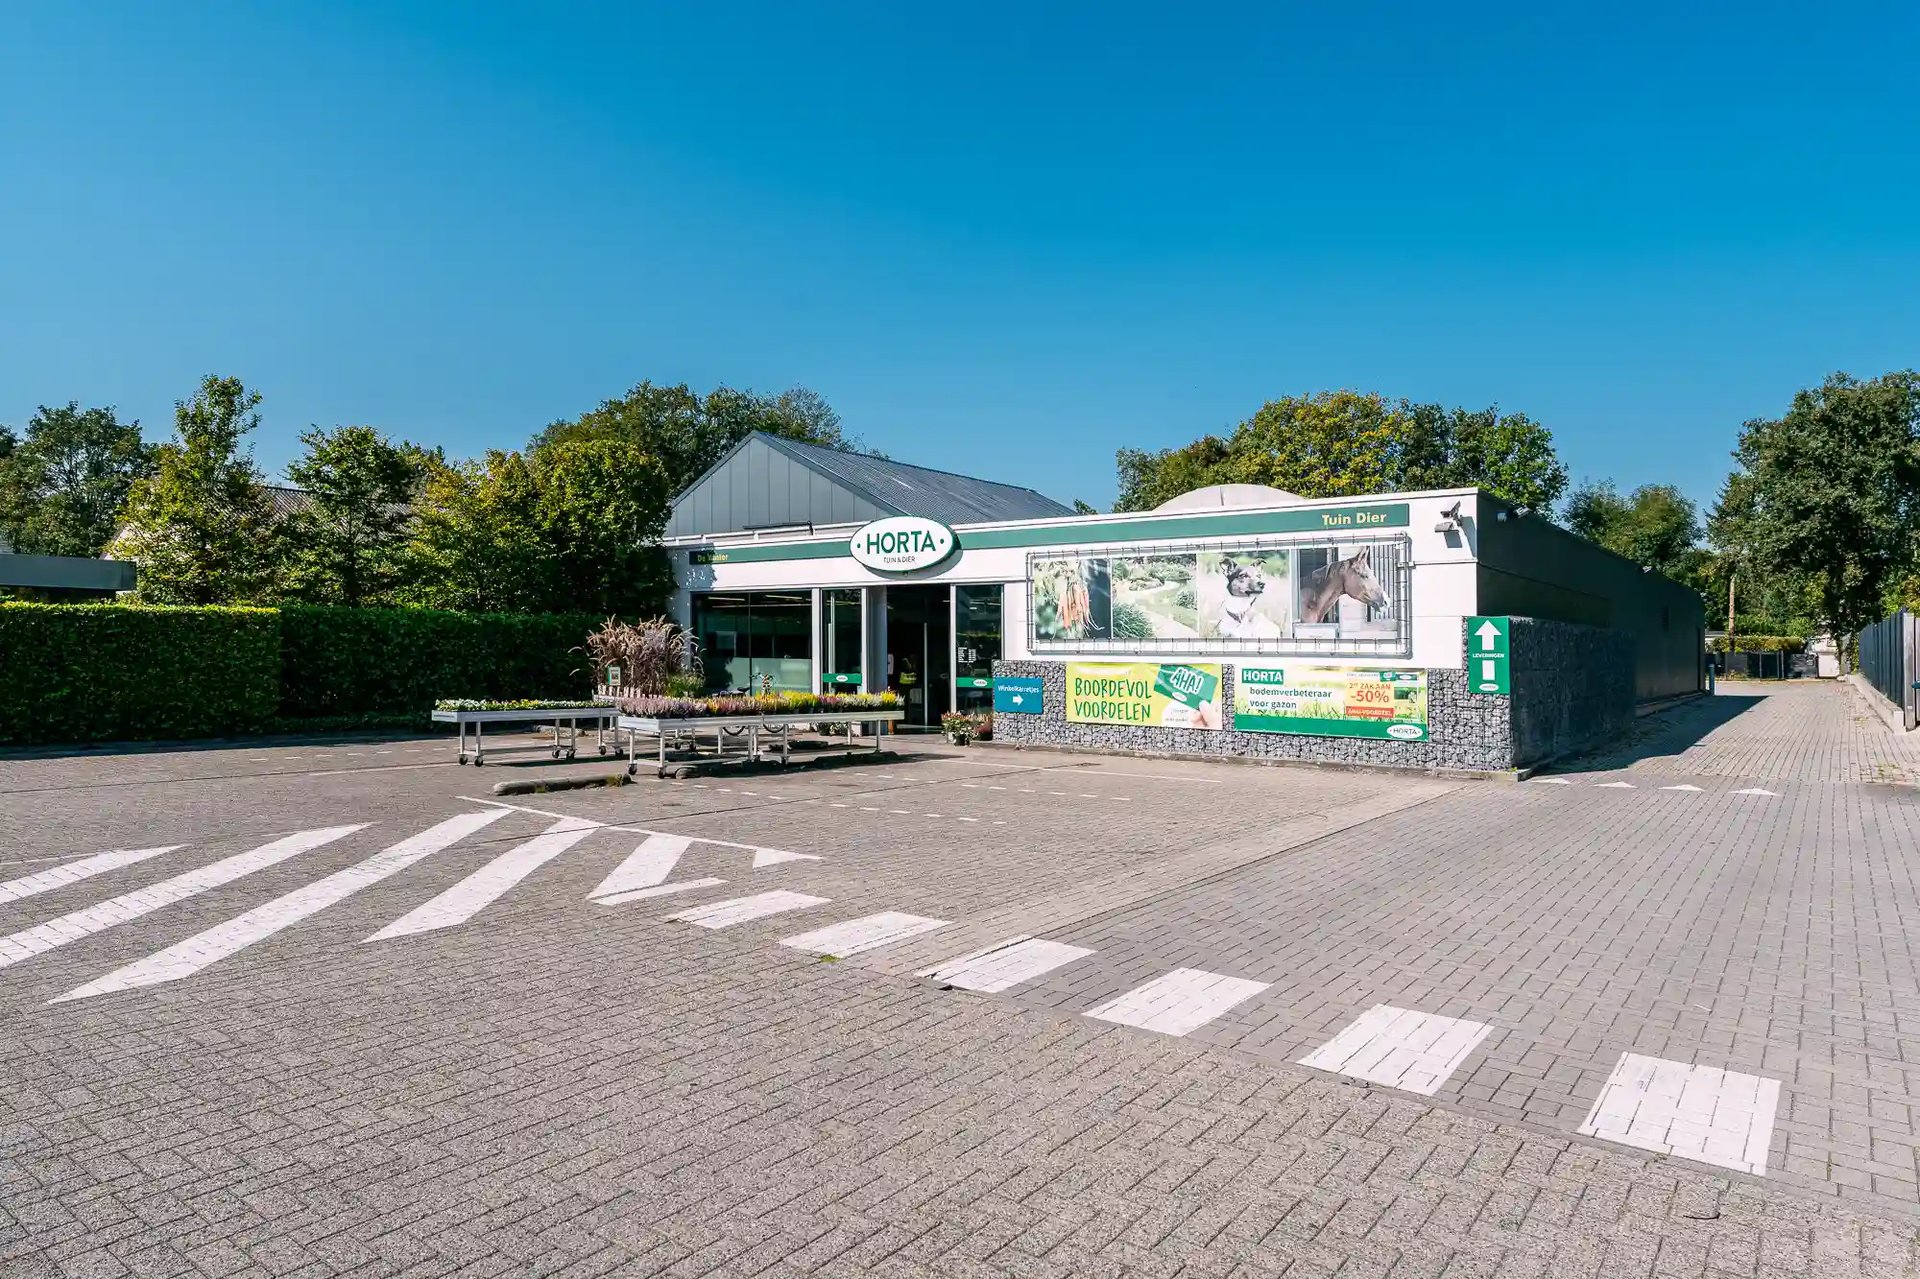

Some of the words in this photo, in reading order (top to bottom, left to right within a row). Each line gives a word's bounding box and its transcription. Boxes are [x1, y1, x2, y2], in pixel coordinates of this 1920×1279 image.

[1321, 513, 1352, 526] Tuin
[1356, 512, 1387, 524] Dier
[866, 530, 937, 555] HORTA
[1170, 667, 1204, 694] AHA!
[1243, 670, 1283, 683] HORTA
[997, 685, 1040, 694] Winkelkarretjes
[1074, 677, 1152, 699] BOORDEVOL
[1249, 686, 1333, 698] bodemverbeteraar
[1350, 690, 1390, 703] -50%
[1074, 699, 1152, 722] VOORDELEN
[1249, 700, 1270, 708] voor
[1271, 701, 1297, 710] gazon
